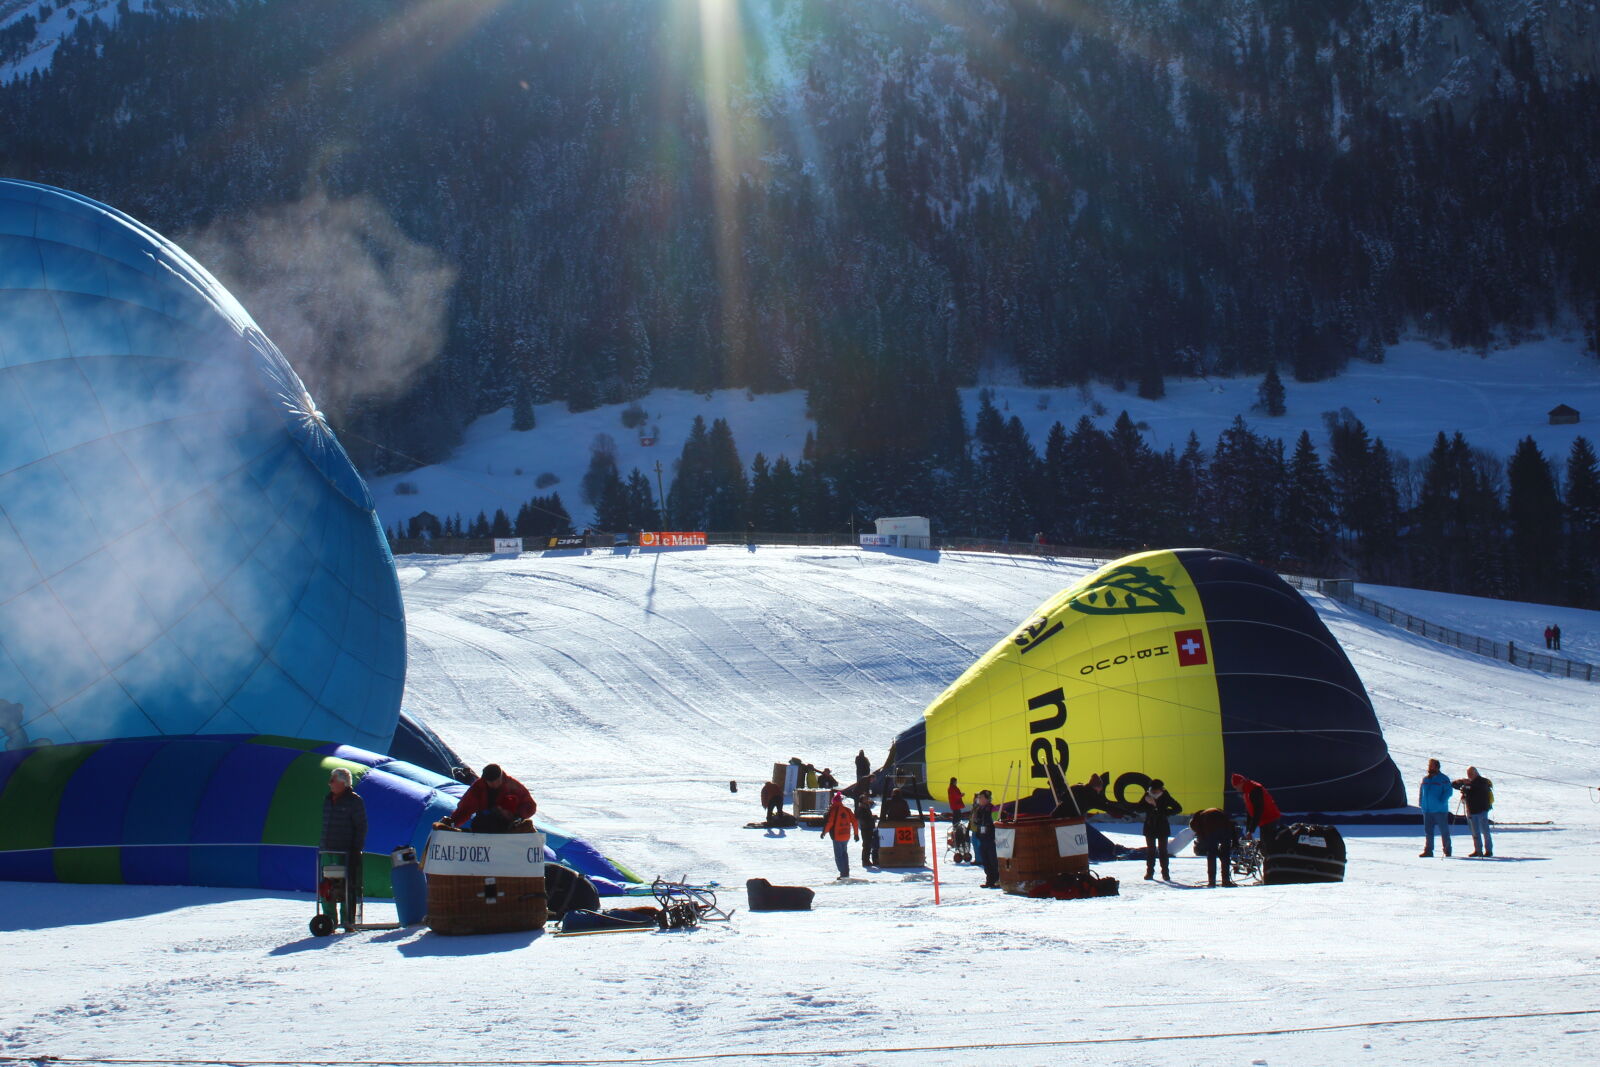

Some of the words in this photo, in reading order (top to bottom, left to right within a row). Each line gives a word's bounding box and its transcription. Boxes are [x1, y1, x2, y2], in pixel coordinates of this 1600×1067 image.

[672, 534, 705, 546] Matin
[898, 830, 912, 841] 32
[430, 844, 491, 863] TEAU-D'OEX
